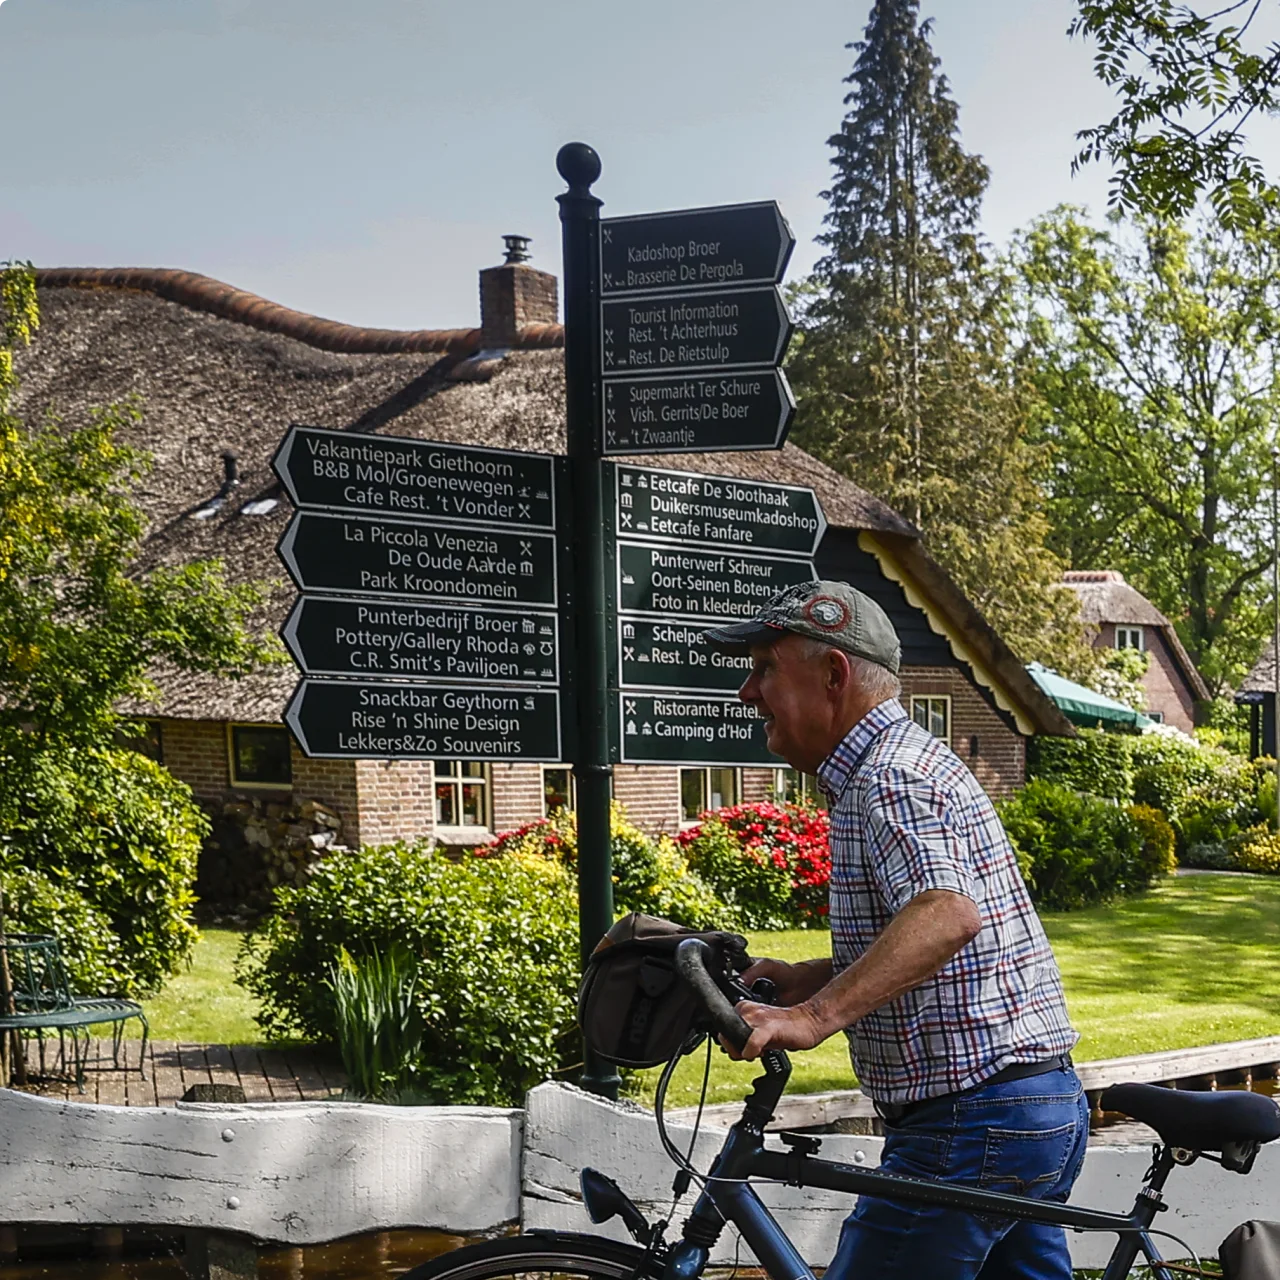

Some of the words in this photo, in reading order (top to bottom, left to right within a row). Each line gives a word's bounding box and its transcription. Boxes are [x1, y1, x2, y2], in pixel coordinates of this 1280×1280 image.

[627, 243, 685, 263] Kadoshop
[689, 241, 721, 257] Broer
[627, 265, 677, 287] Brasserie
[680, 264, 697, 281] De
[700, 259, 744, 282] Pergola
[628, 307, 667, 325] Tourist
[670, 300, 739, 322] Information
[628, 327, 656, 343] Rest.
[671, 321, 739, 340] Achterhuus
[629, 348, 656, 365] Rest.
[660, 347, 676, 363] De
[678, 342, 730, 363] Rietstulp
[629, 383, 695, 405] Supermarkt
[698, 381, 717, 398] Ter
[720, 379, 761, 397] Schure
[630, 406, 658, 423] Vish.
[661, 403, 719, 422] Gerrits/De
[722, 402, 749, 419] Boer
[642, 425, 695, 447] Zwaantje
[306, 437, 423, 468] Vakantiepark
[428, 451, 514, 478] Giethoorn
[313, 459, 350, 480] B&B
[356, 463, 514, 499] Mol/Groenewegen
[650, 474, 700, 496] Eetcafe
[703, 482, 722, 499] De
[725, 484, 790, 508] Sloothaak
[344, 486, 384, 506] Cafe
[389, 489, 430, 511] Rest.
[452, 496, 515, 519] Vonder
[650, 495, 818, 533] Duikersmuseumkadoshop
[344, 523, 365, 542] La
[371, 526, 429, 548] Piccola
[434, 532, 499, 554] Venezia
[651, 516, 701, 536] Eetcafe
[704, 522, 754, 543] Fanfare
[389, 549, 412, 567] De
[416, 551, 463, 571] Oude
[466, 555, 517, 576] Aarde
[651, 550, 725, 574] Punterwerf
[728, 558, 773, 578] Schreur
[361, 570, 398, 590] Park
[403, 573, 518, 598] Kroondomein
[651, 571, 731, 594] Oort-Seinen
[652, 592, 682, 611] Foto
[686, 594, 699, 611] in
[703, 595, 763, 616] klederdra
[357, 606, 470, 634] Punterbedrijf
[475, 615, 518, 634] Broer
[336, 628, 462, 655] Pottery/Gallery
[467, 635, 519, 655] Rhoda
[652, 625, 707, 648] Schelpe
[350, 650, 384, 669] C.R.
[390, 652, 442, 672] Smit's
[447, 656, 519, 678] Paviljoen
[652, 647, 684, 665] Rest.
[689, 649, 707, 666] De
[359, 689, 438, 709] Snackbar
[443, 693, 520, 713] Geythorn
[653, 700, 720, 717] Ristorante
[723, 702, 766, 720] Fratel
[352, 711, 386, 729] Rise
[413, 713, 460, 731] Shine
[465, 714, 520, 735] Design
[654, 721, 714, 742] Camping
[718, 723, 754, 740] d'Hof
[339, 732, 438, 752] Lekkers&Zo
[443, 736, 522, 754] Souvenirs
